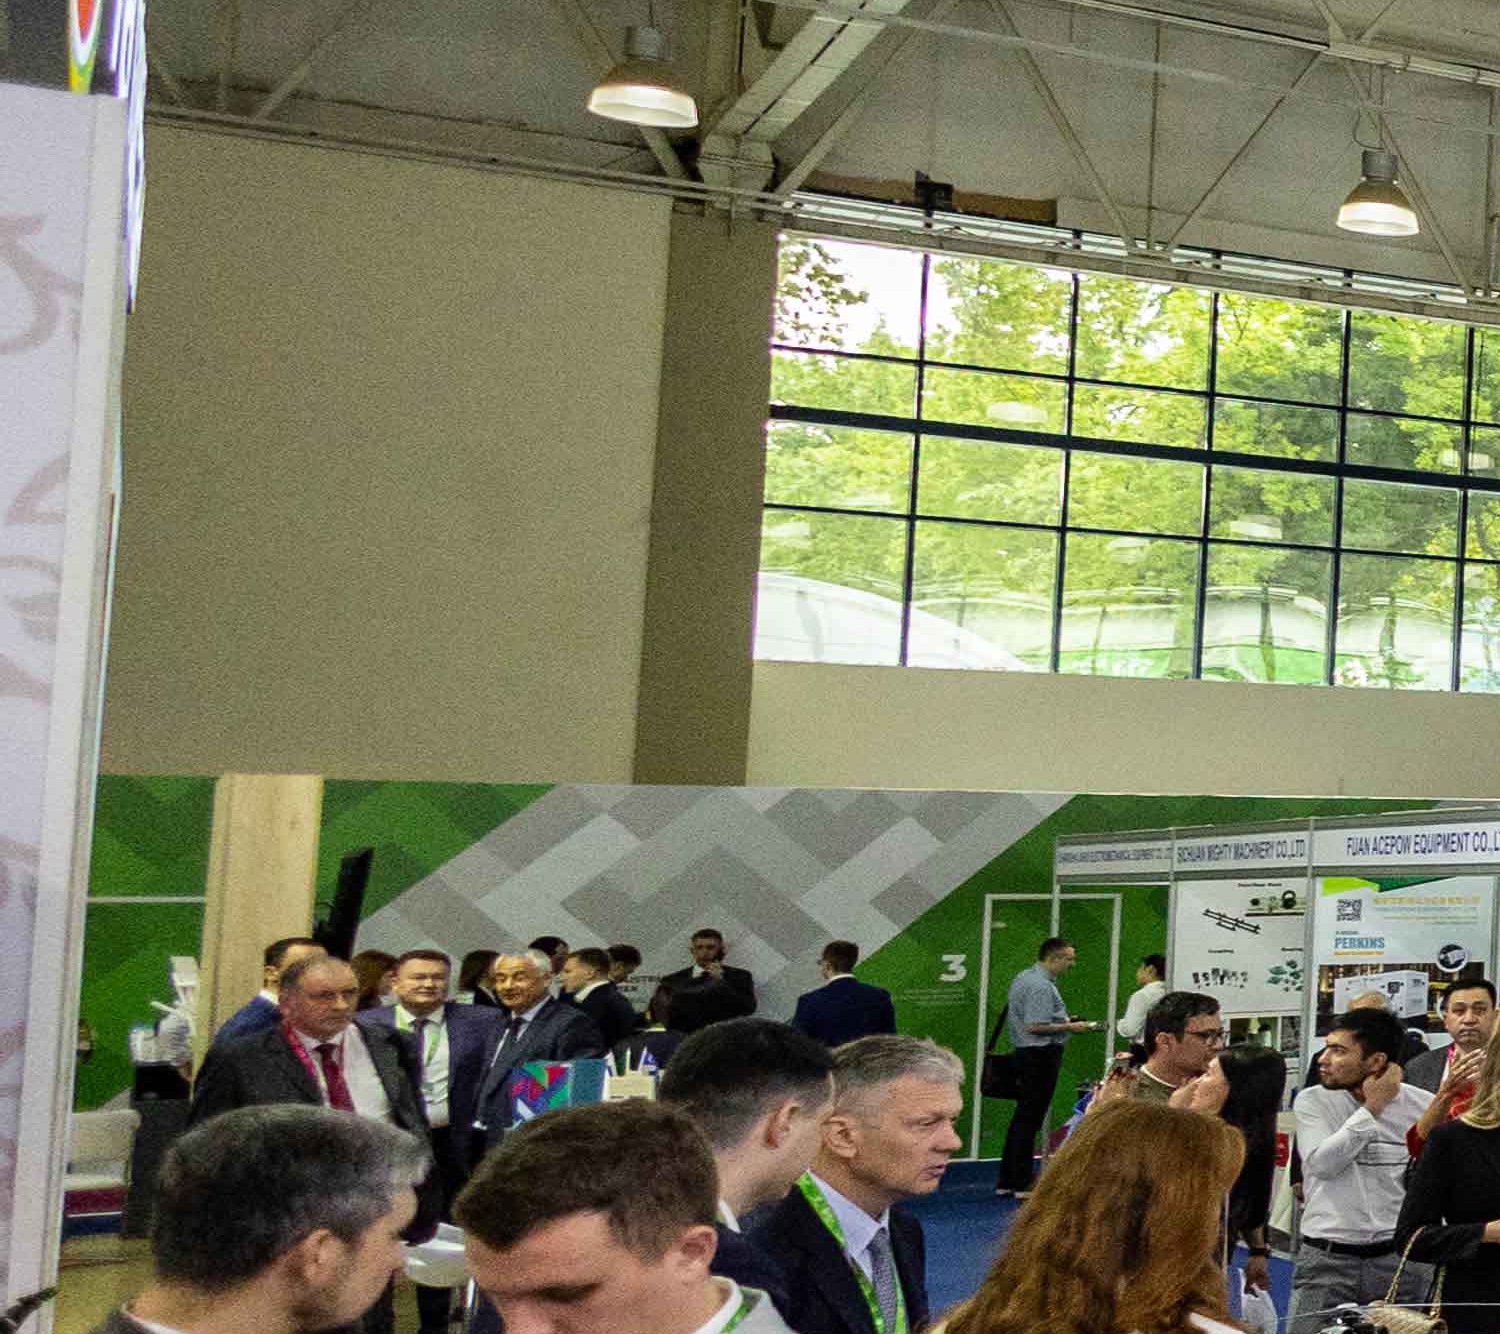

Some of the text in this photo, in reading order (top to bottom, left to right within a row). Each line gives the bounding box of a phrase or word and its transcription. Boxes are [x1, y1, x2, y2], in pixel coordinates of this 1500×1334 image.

[1414, 831, 1470, 855] EQUIPMENT
[1334, 936, 1385, 950] PERKINS
[940, 954, 968, 982] 3
